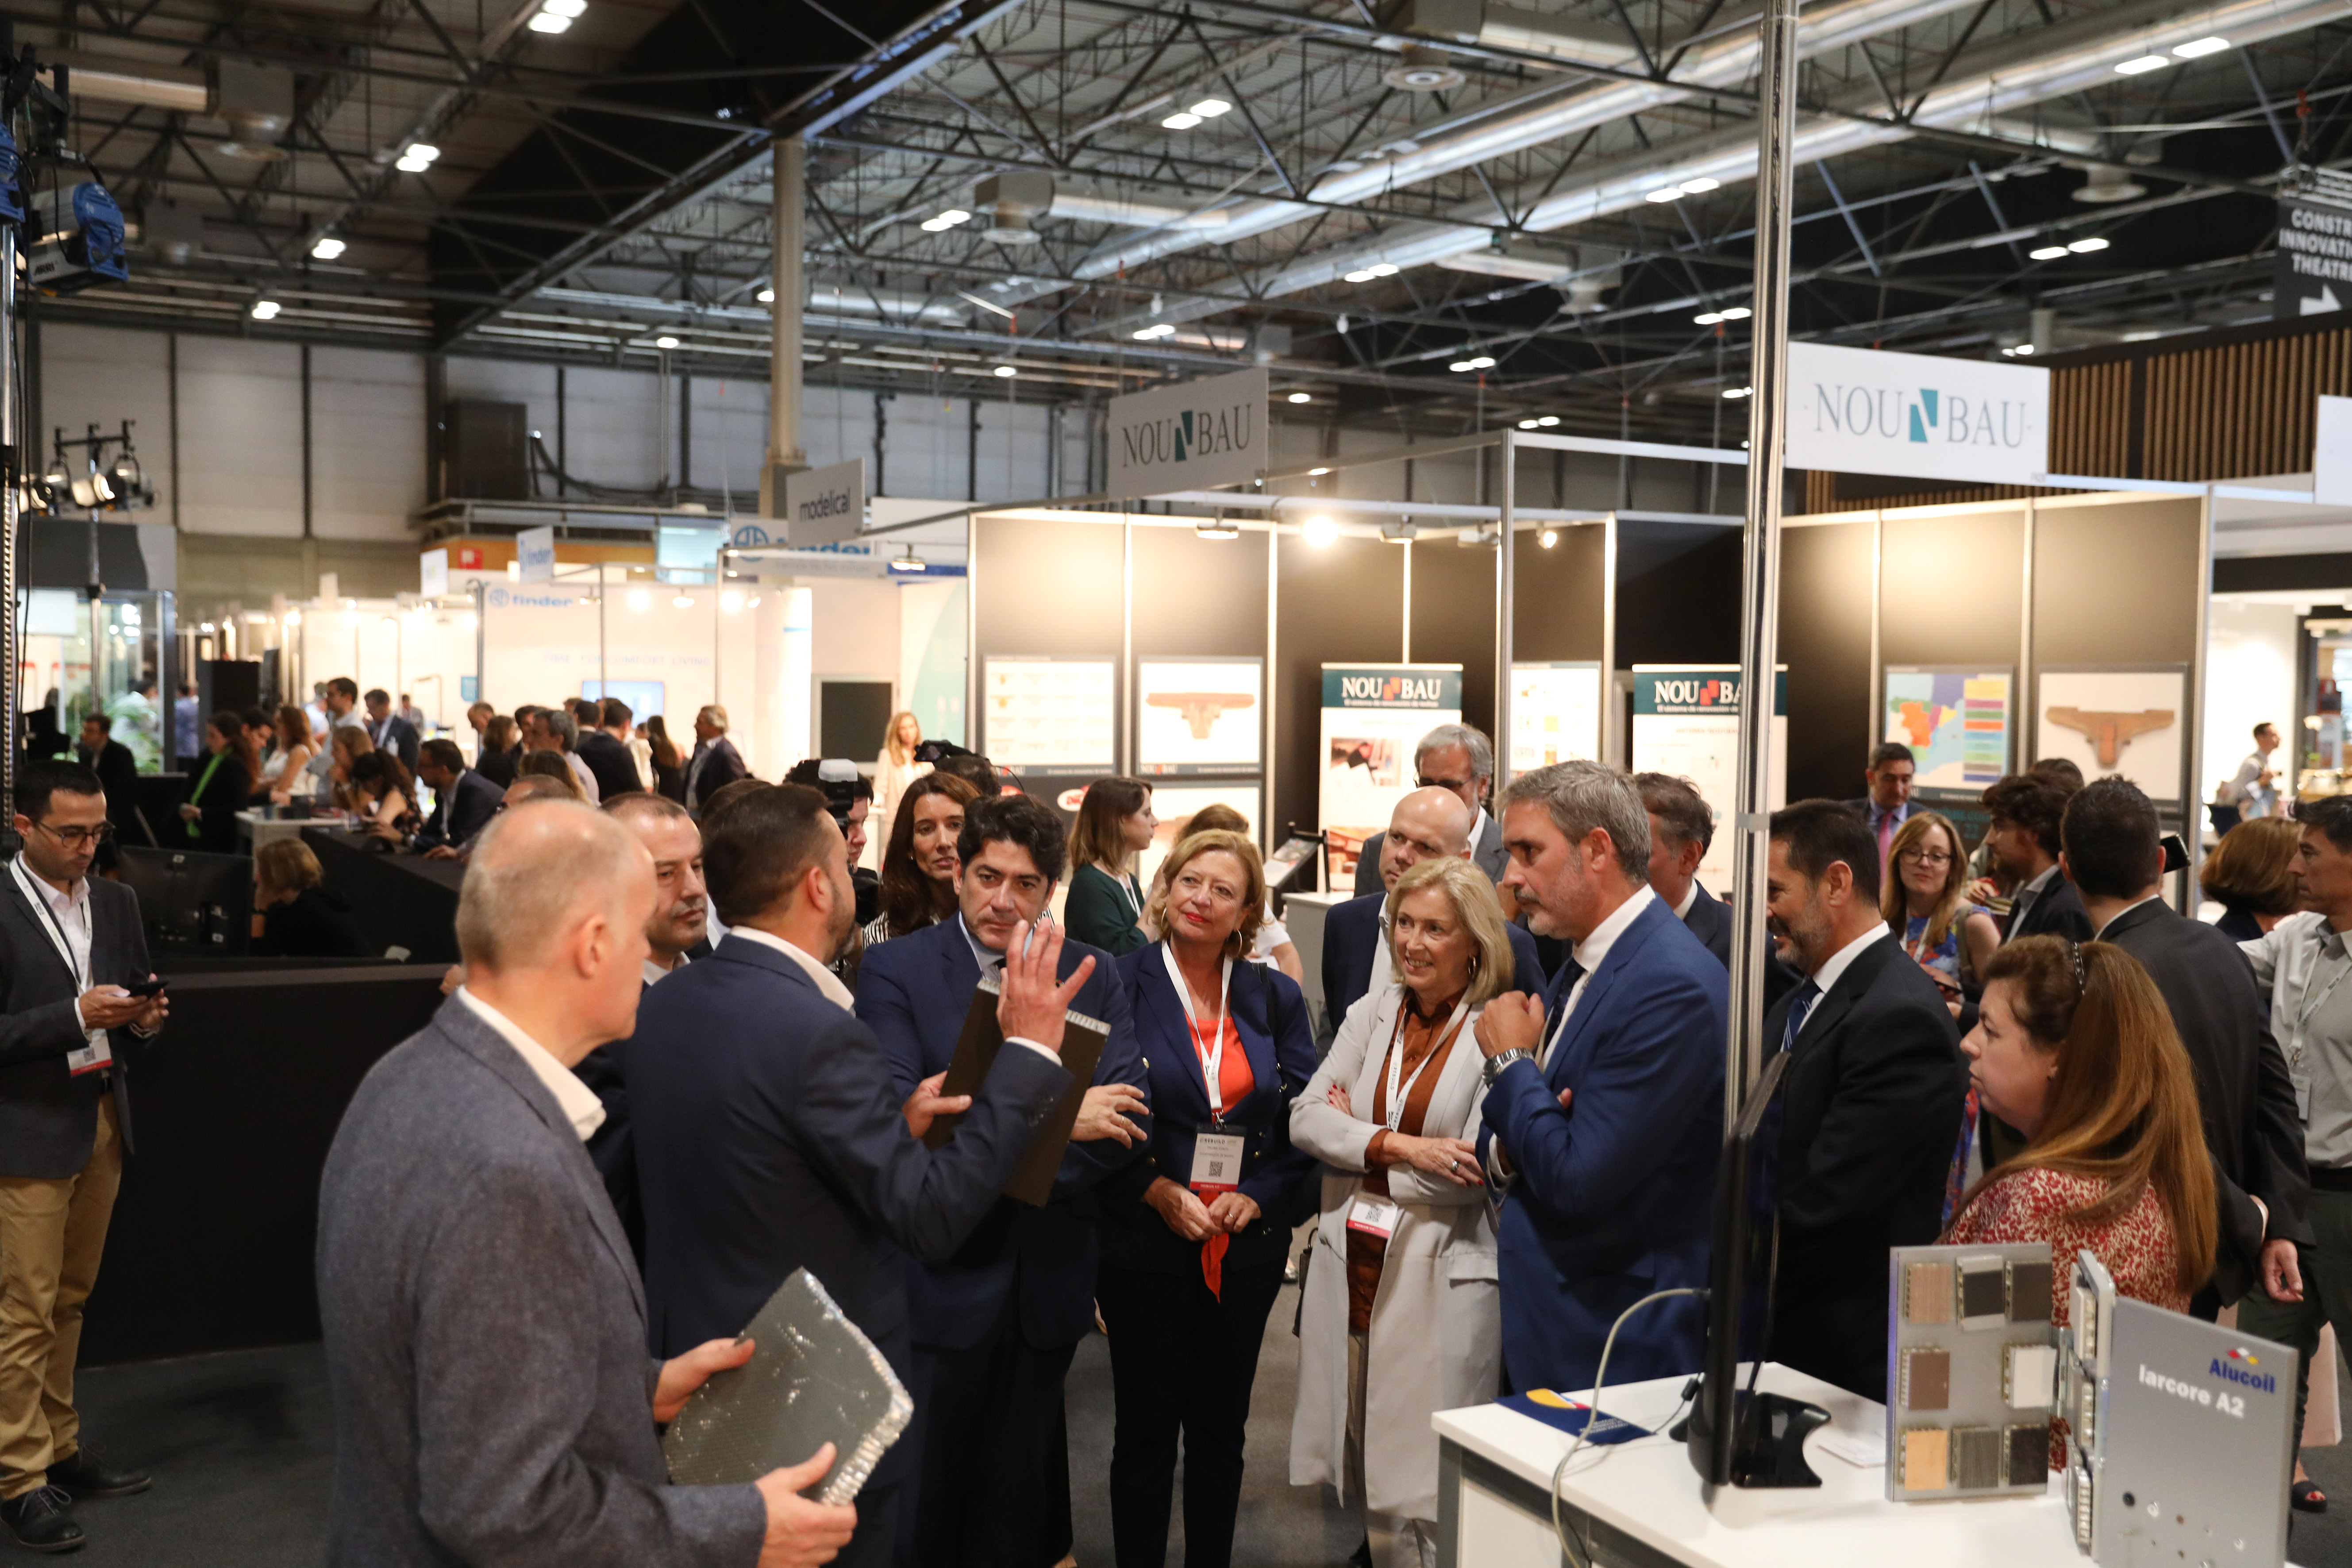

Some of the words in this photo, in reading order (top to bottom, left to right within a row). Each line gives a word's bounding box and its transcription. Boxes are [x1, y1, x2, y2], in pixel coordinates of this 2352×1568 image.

[2279, 228, 2352, 260] INNOVATI
[799, 486, 850, 521] modelical
[2209, 1358, 2275, 1394] Alucoil
[2216, 1391, 2245, 1419] A2
